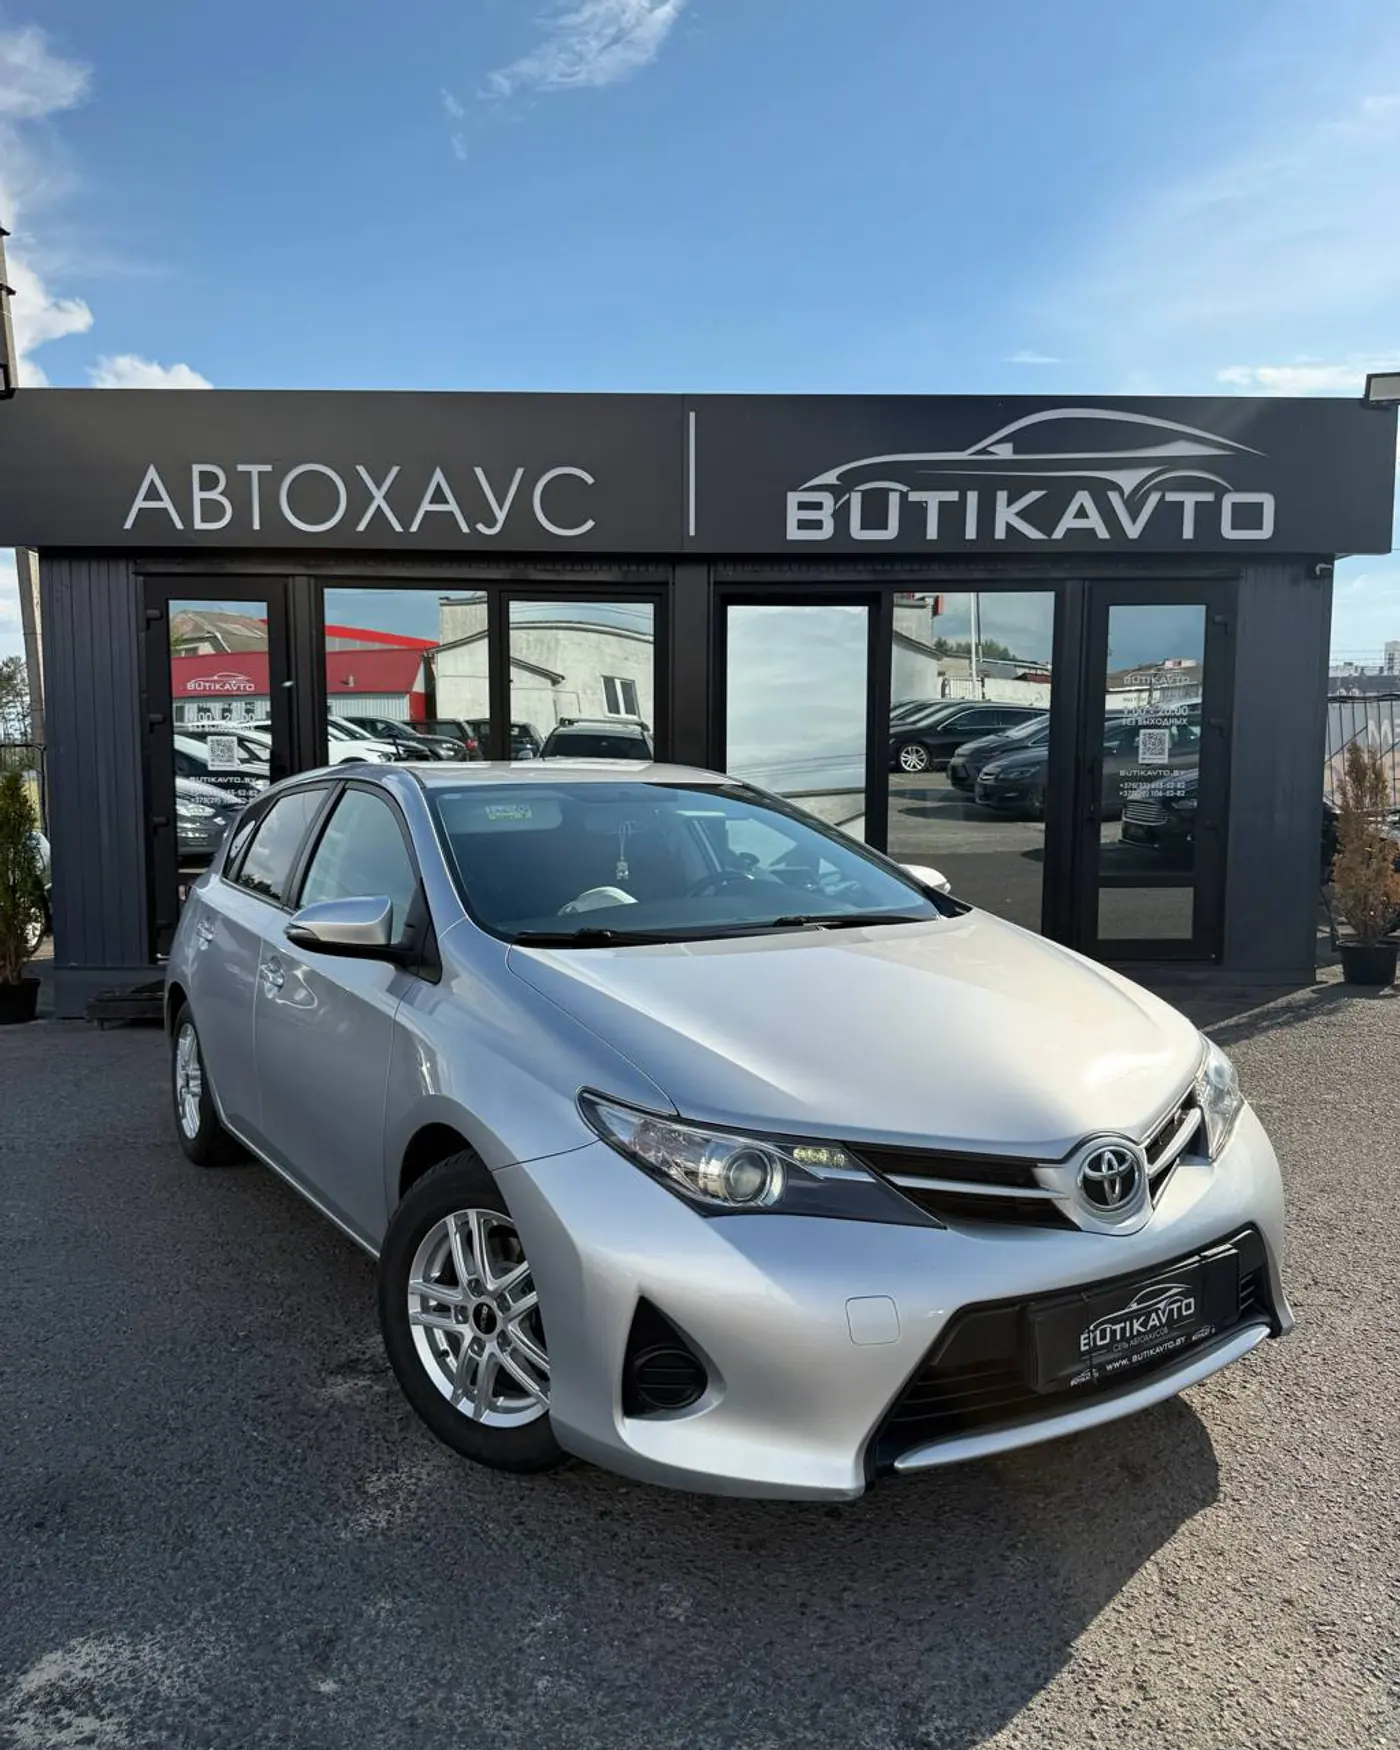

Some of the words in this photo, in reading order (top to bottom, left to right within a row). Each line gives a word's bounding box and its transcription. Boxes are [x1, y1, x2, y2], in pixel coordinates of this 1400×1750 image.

[124, 463, 596, 536] АВТОХАУС
[786, 490, 1275, 540] BUTIKAVTO
[187, 682, 255, 691] BUTIKAVTO
[1080, 1298, 1195, 1351] BUTIKAVTO
